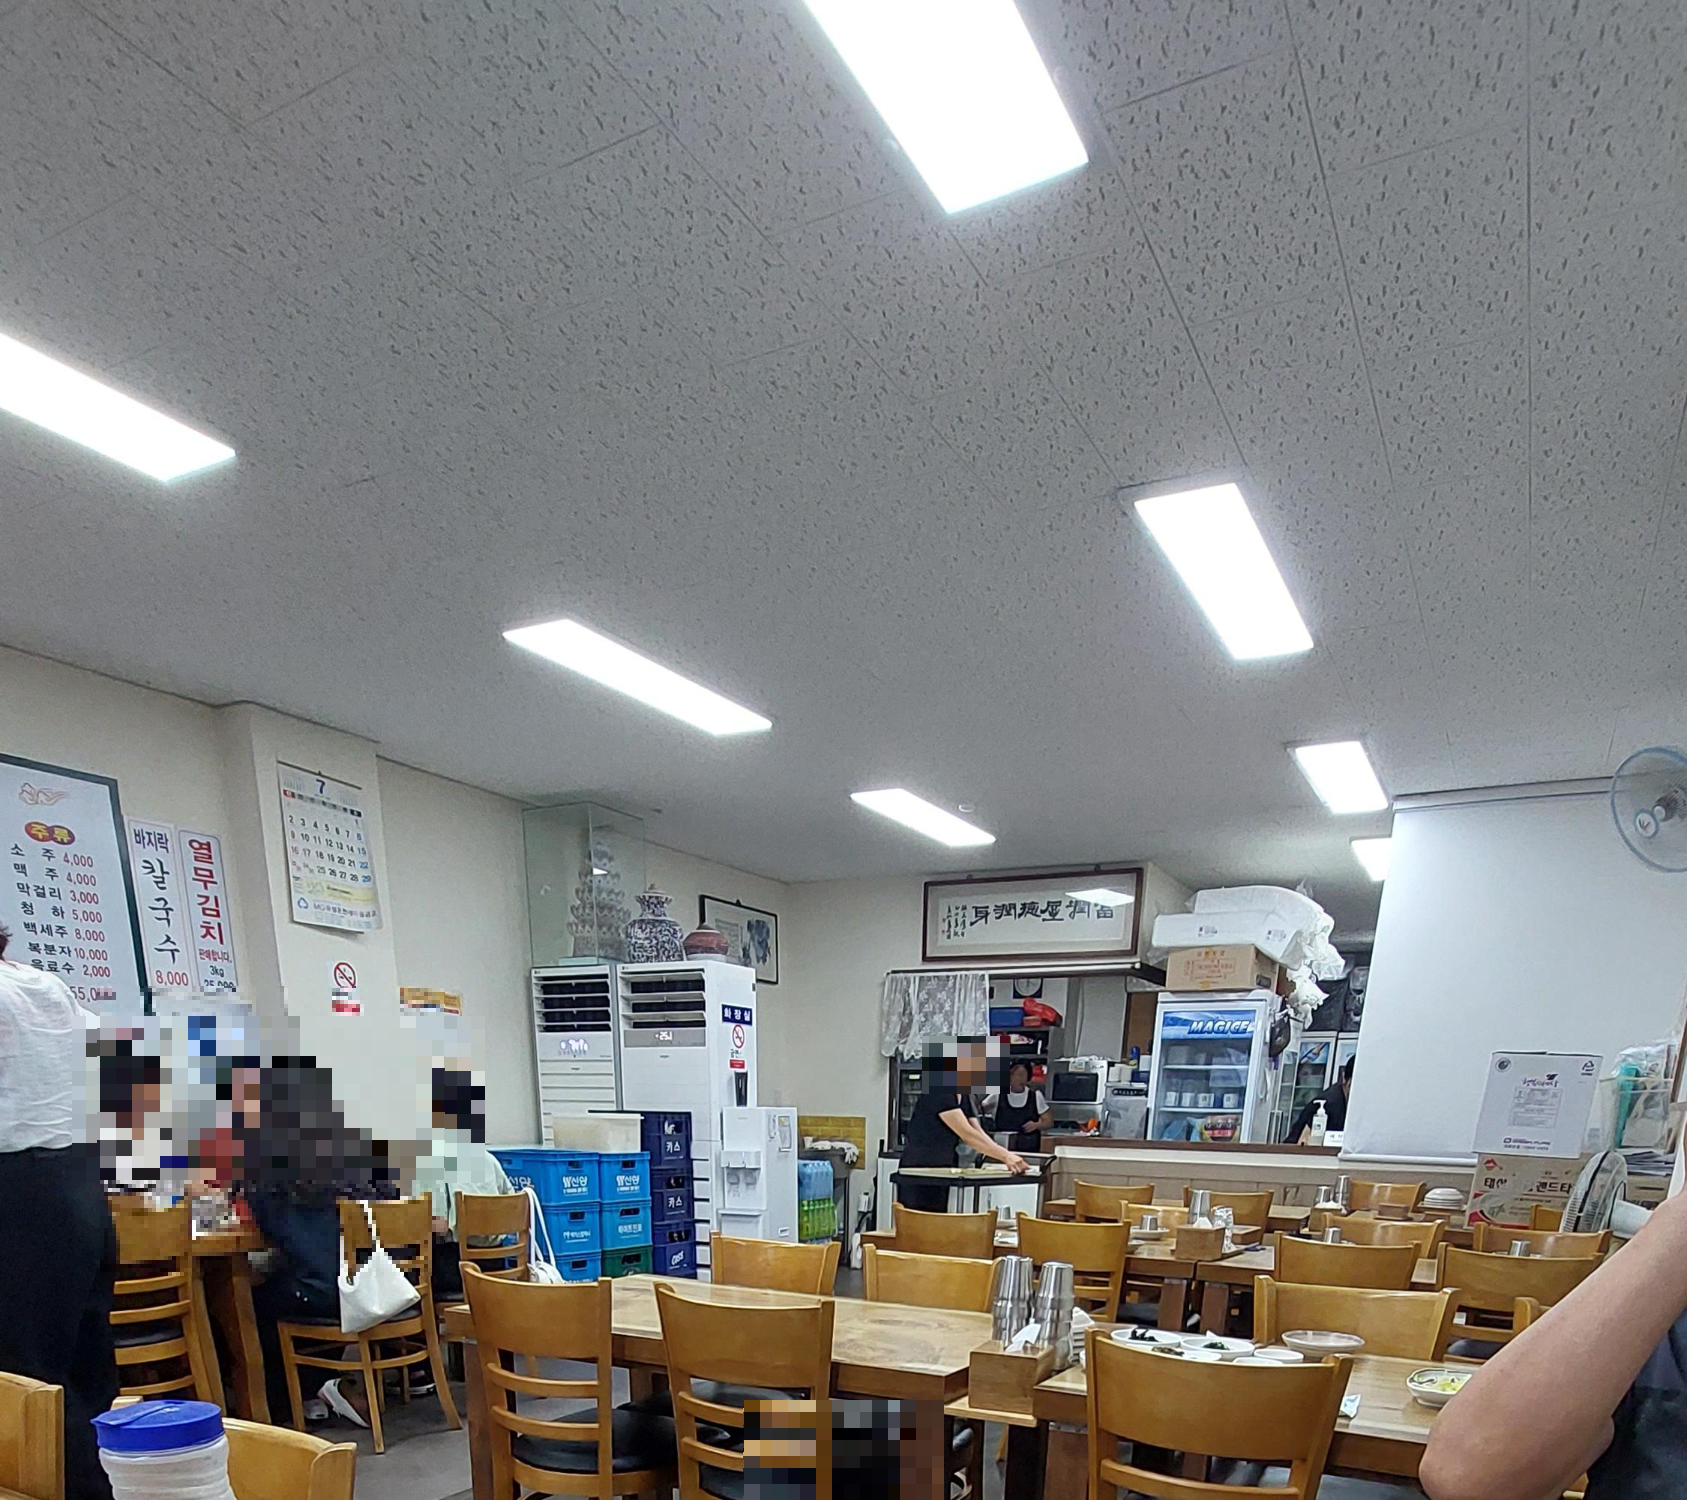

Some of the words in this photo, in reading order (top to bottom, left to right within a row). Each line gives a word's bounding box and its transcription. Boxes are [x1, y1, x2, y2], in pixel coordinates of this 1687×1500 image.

[316, 779, 325, 794] 7
[30, 823, 71, 843] 주류
[288, 815, 294, 824] 2
[301, 818, 306, 827] 3
[313, 821, 319, 830] 4
[325, 823, 330, 832] 5
[346, 830, 351, 839] 7
[133, 828, 169, 853] 바지락
[301, 833, 310, 842] 10
[313, 836, 321, 845] 11
[325, 838, 334, 848] 12
[336, 841, 344, 851] 13
[346, 844, 355, 854] 14
[357, 847, 367, 856] 15
[63, 852, 94, 868] 4,000
[291, 846, 299, 855] 16
[303, 848, 311, 857] 17
[315, 850, 324, 860] 18
[327, 853, 335, 863] 19
[337, 856, 346, 865] 20
[348, 858, 356, 868] 21
[360, 861, 369, 870] 22
[66, 872, 97, 887] 4,000
[317, 865, 326, 875] 25
[329, 868, 337, 877] 26
[339, 871, 347, 880] 27
[350, 873, 359, 883] 28
[361, 875, 371, 884] 29
[16, 882, 61, 900] 막걸리
[69, 889, 99, 905] 3,000
[188, 838, 225, 946] 열무김치
[72, 909, 102, 923] 5,000
[141, 857, 181, 965] 칼국수
[23, 921, 68, 938] 백세주
[74, 928, 105, 942] 8,000
[28, 941, 72, 957] 복분자
[74, 947, 108, 961] 10,000
[31, 959, 75, 975] 음료수
[82, 964, 111, 978] 2,000
[155, 969, 189, 986] 8,000
[209, 965, 224, 978] 3kg
[723, 1007, 751, 1022] 화장실
[666, 1141, 681, 1154] 카스
[668, 1195, 683, 1209] 카스
